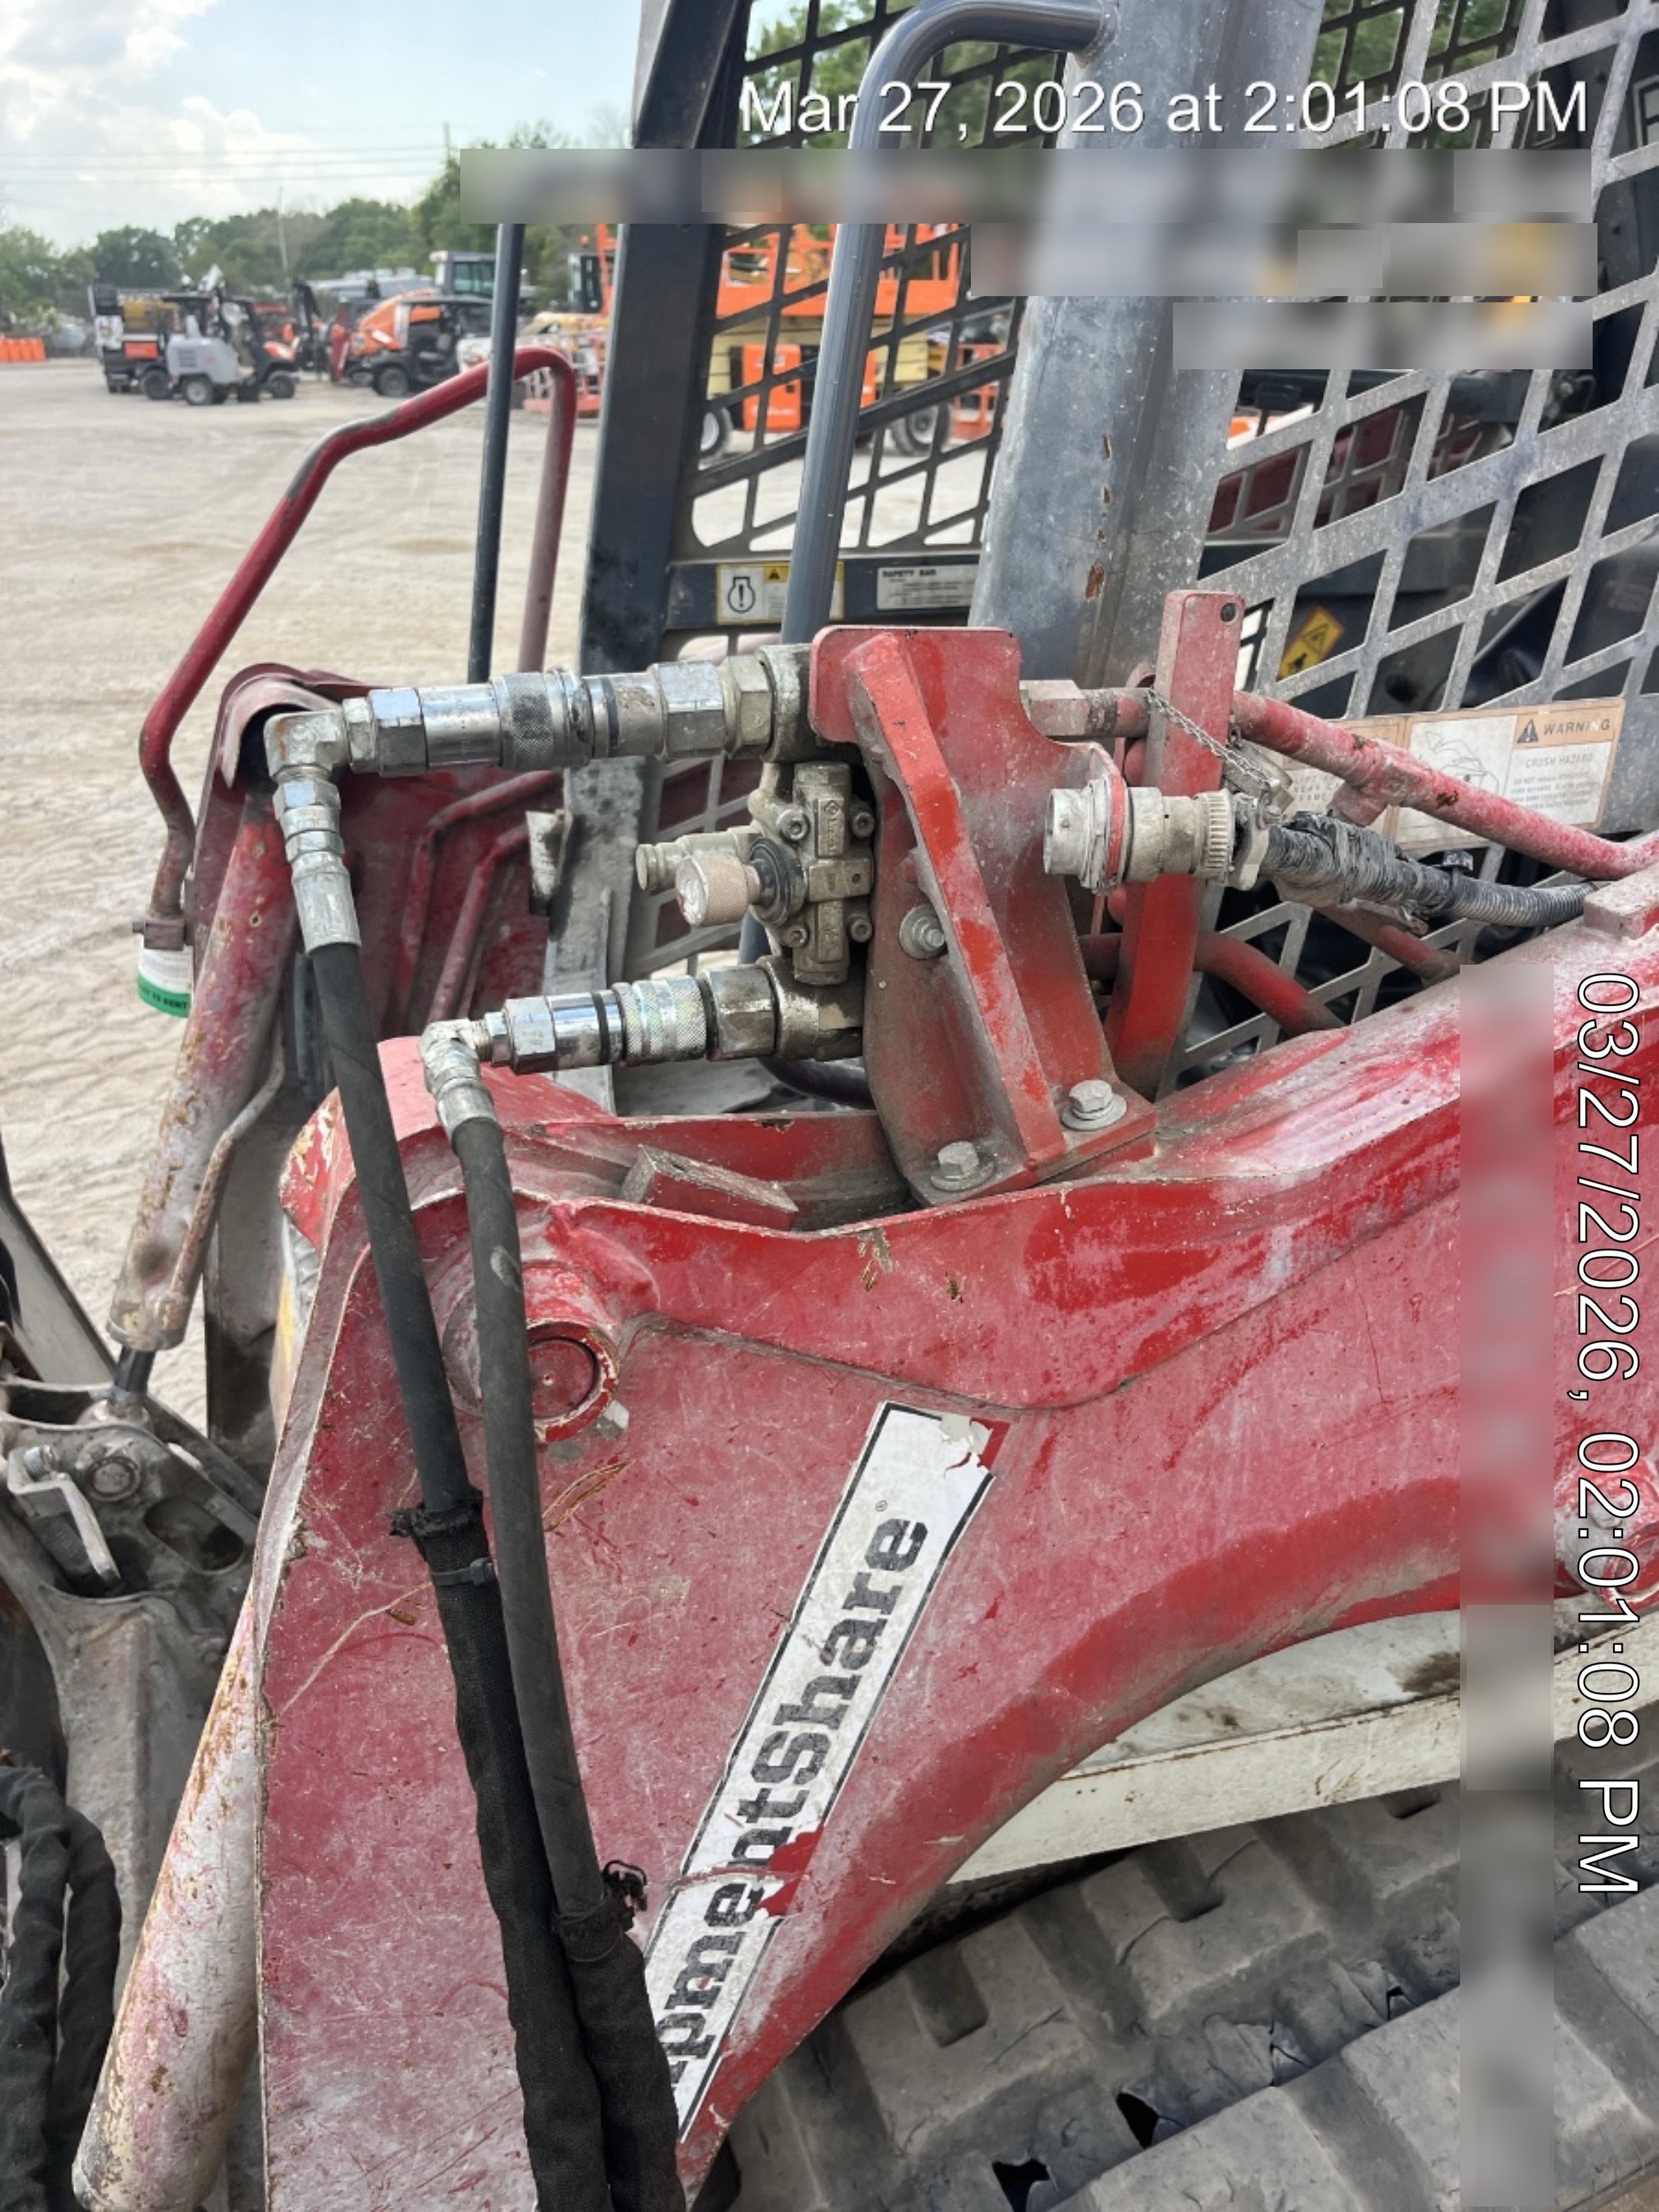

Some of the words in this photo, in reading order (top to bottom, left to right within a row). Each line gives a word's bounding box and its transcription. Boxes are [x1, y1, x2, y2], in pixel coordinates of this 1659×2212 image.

[1543, 718, 1610, 735] WARNING
[1525, 757, 1556, 769] CRUSH
[1559, 753, 1594, 766] HAZARD
